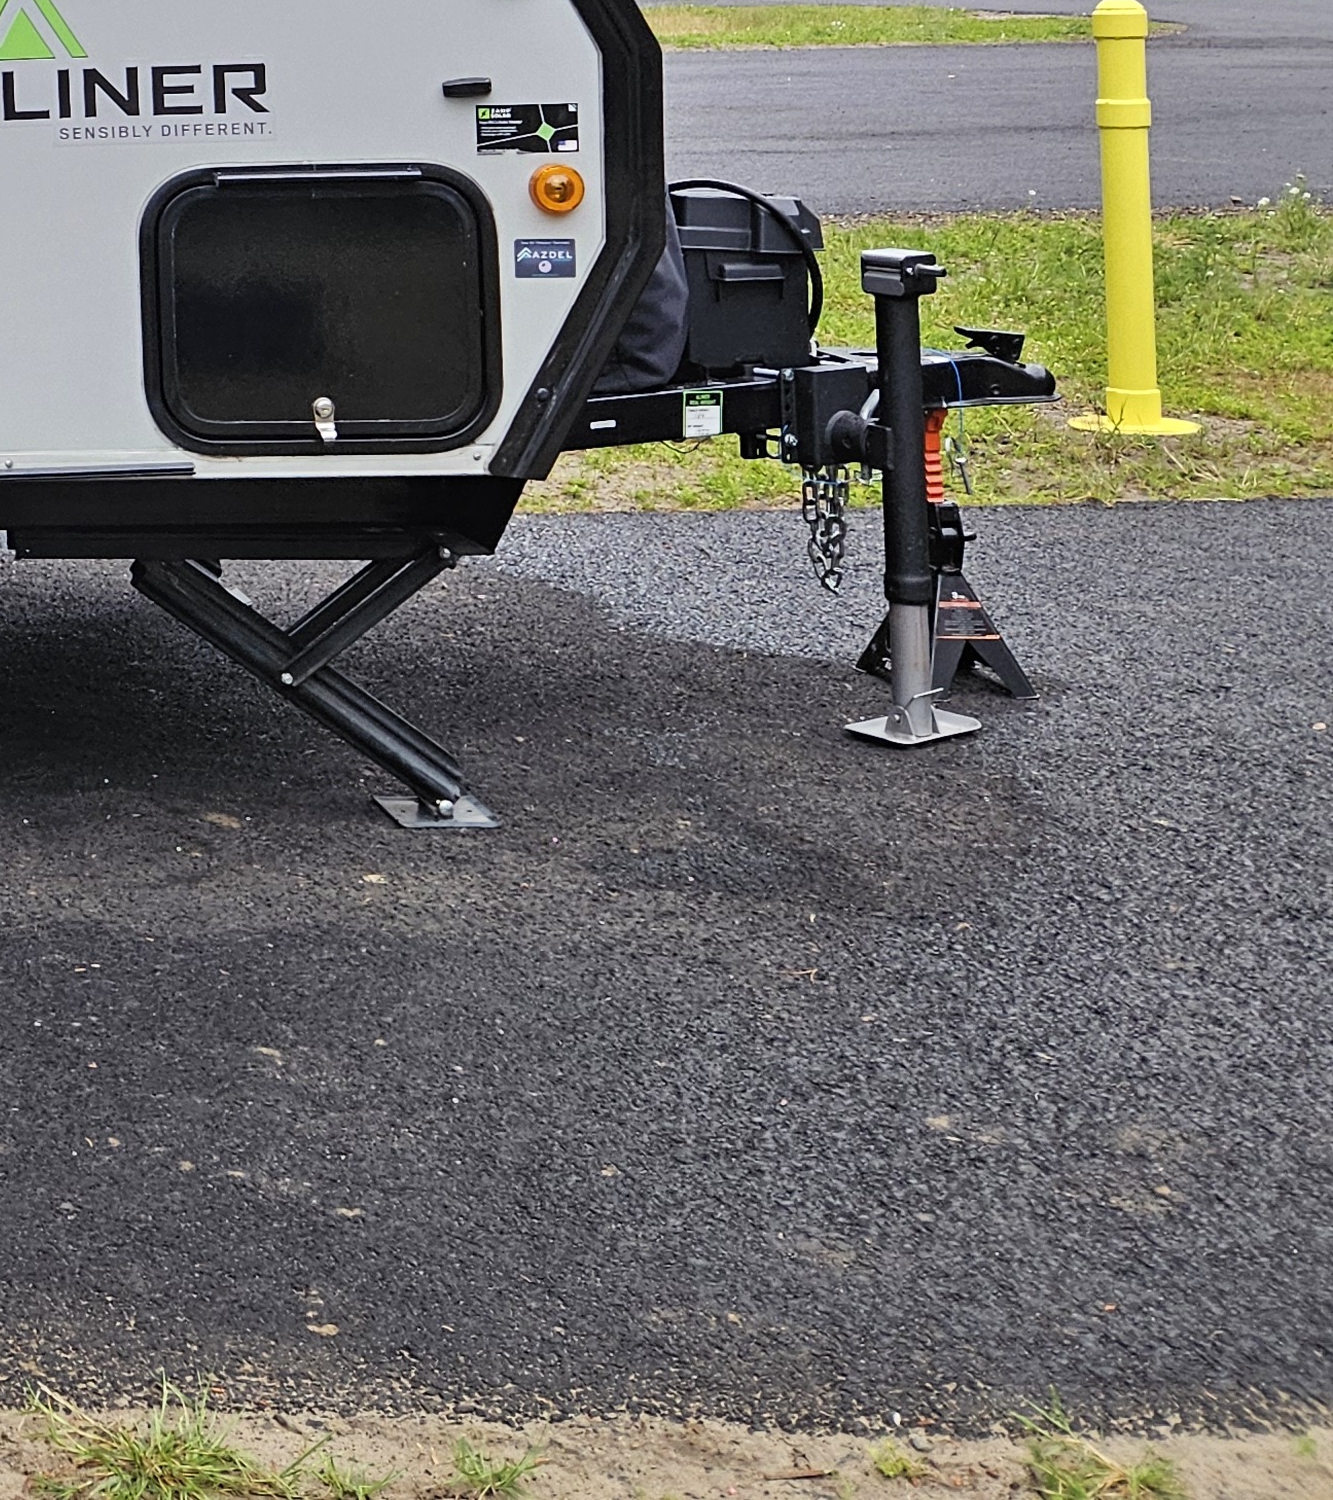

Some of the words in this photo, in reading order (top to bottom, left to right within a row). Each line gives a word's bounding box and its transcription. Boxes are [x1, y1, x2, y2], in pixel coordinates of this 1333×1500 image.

[59, 124, 153, 140] SENSIBLY
[161, 122, 273, 138] DIFFERENT.
[532, 250, 573, 259] AZDEL
